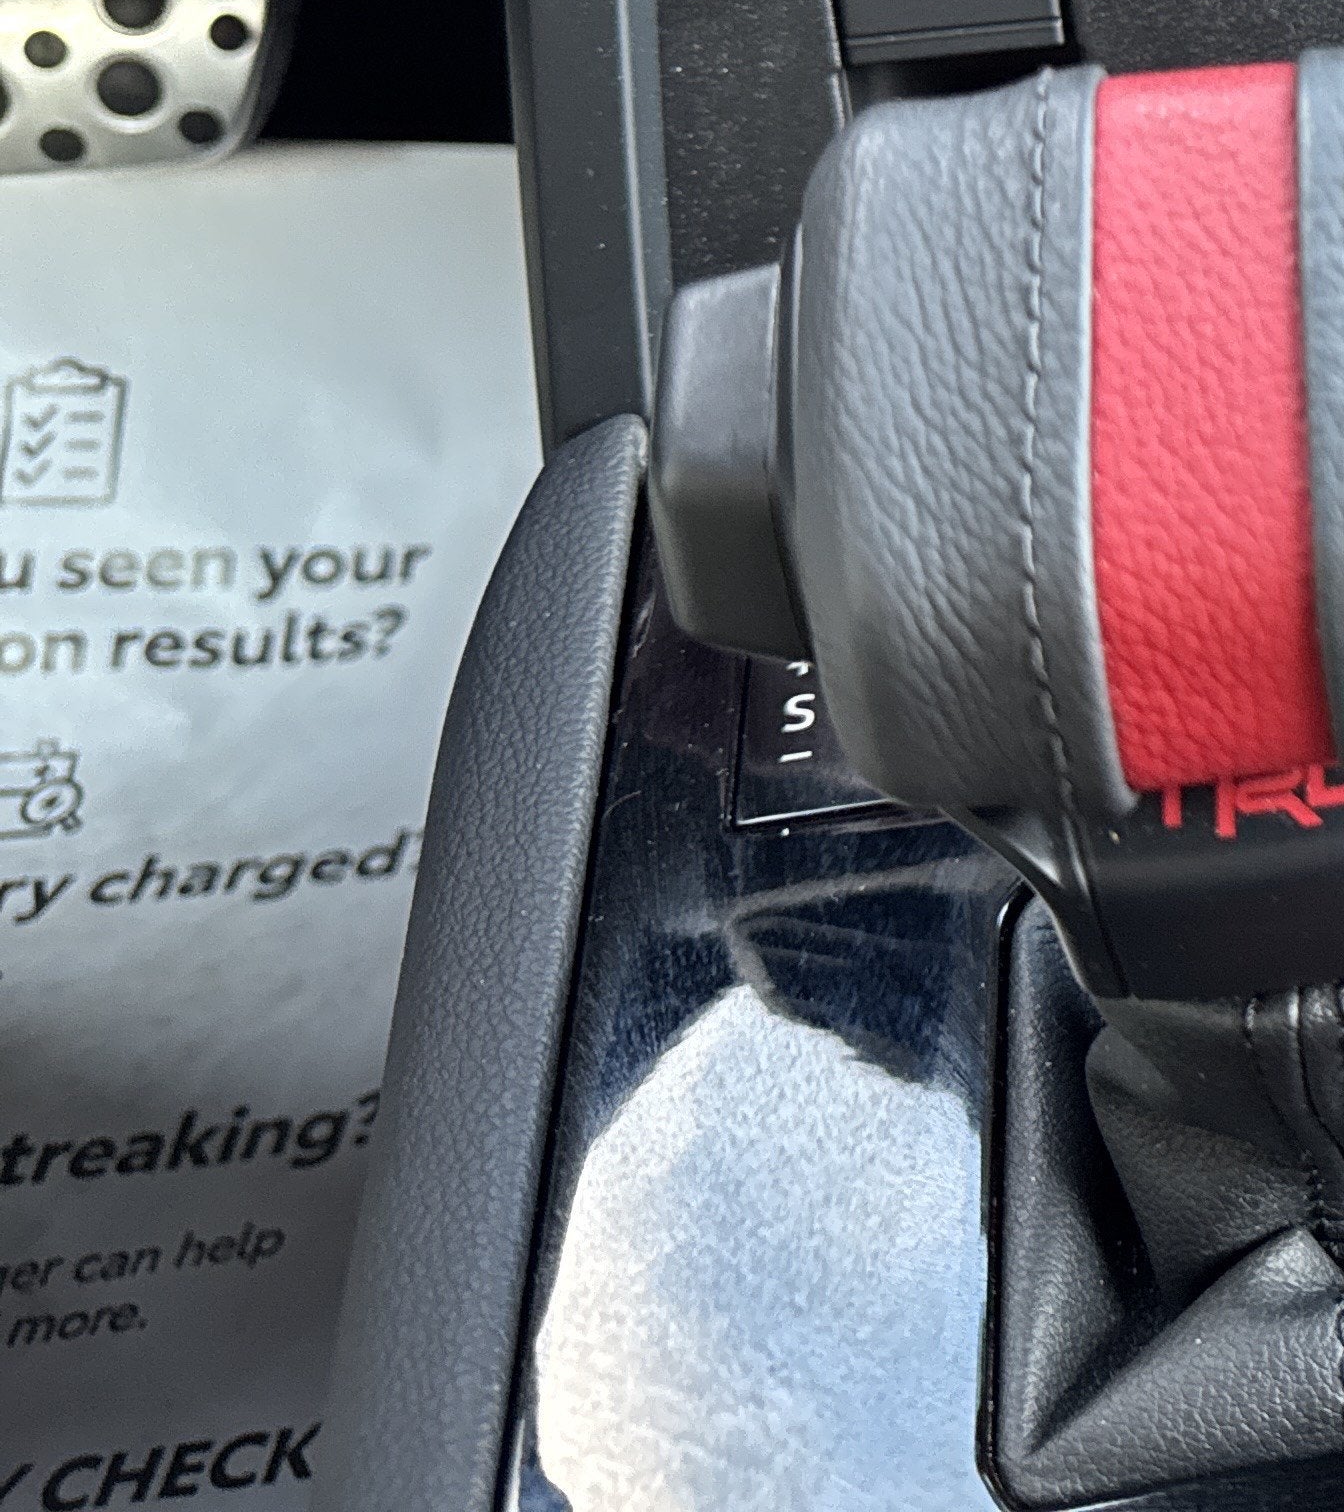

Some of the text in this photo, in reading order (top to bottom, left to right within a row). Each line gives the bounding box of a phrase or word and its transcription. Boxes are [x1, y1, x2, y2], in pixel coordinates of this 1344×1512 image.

[57, 547, 237, 590] seen
[255, 543, 432, 603] your
[0, 602, 409, 674] on results?
[780, 693, 816, 732] S
[72, 1245, 163, 1285] can
[174, 1221, 288, 1269] help
[6, 1301, 148, 1349] more.
[41, 1422, 323, 1512] CHECK
